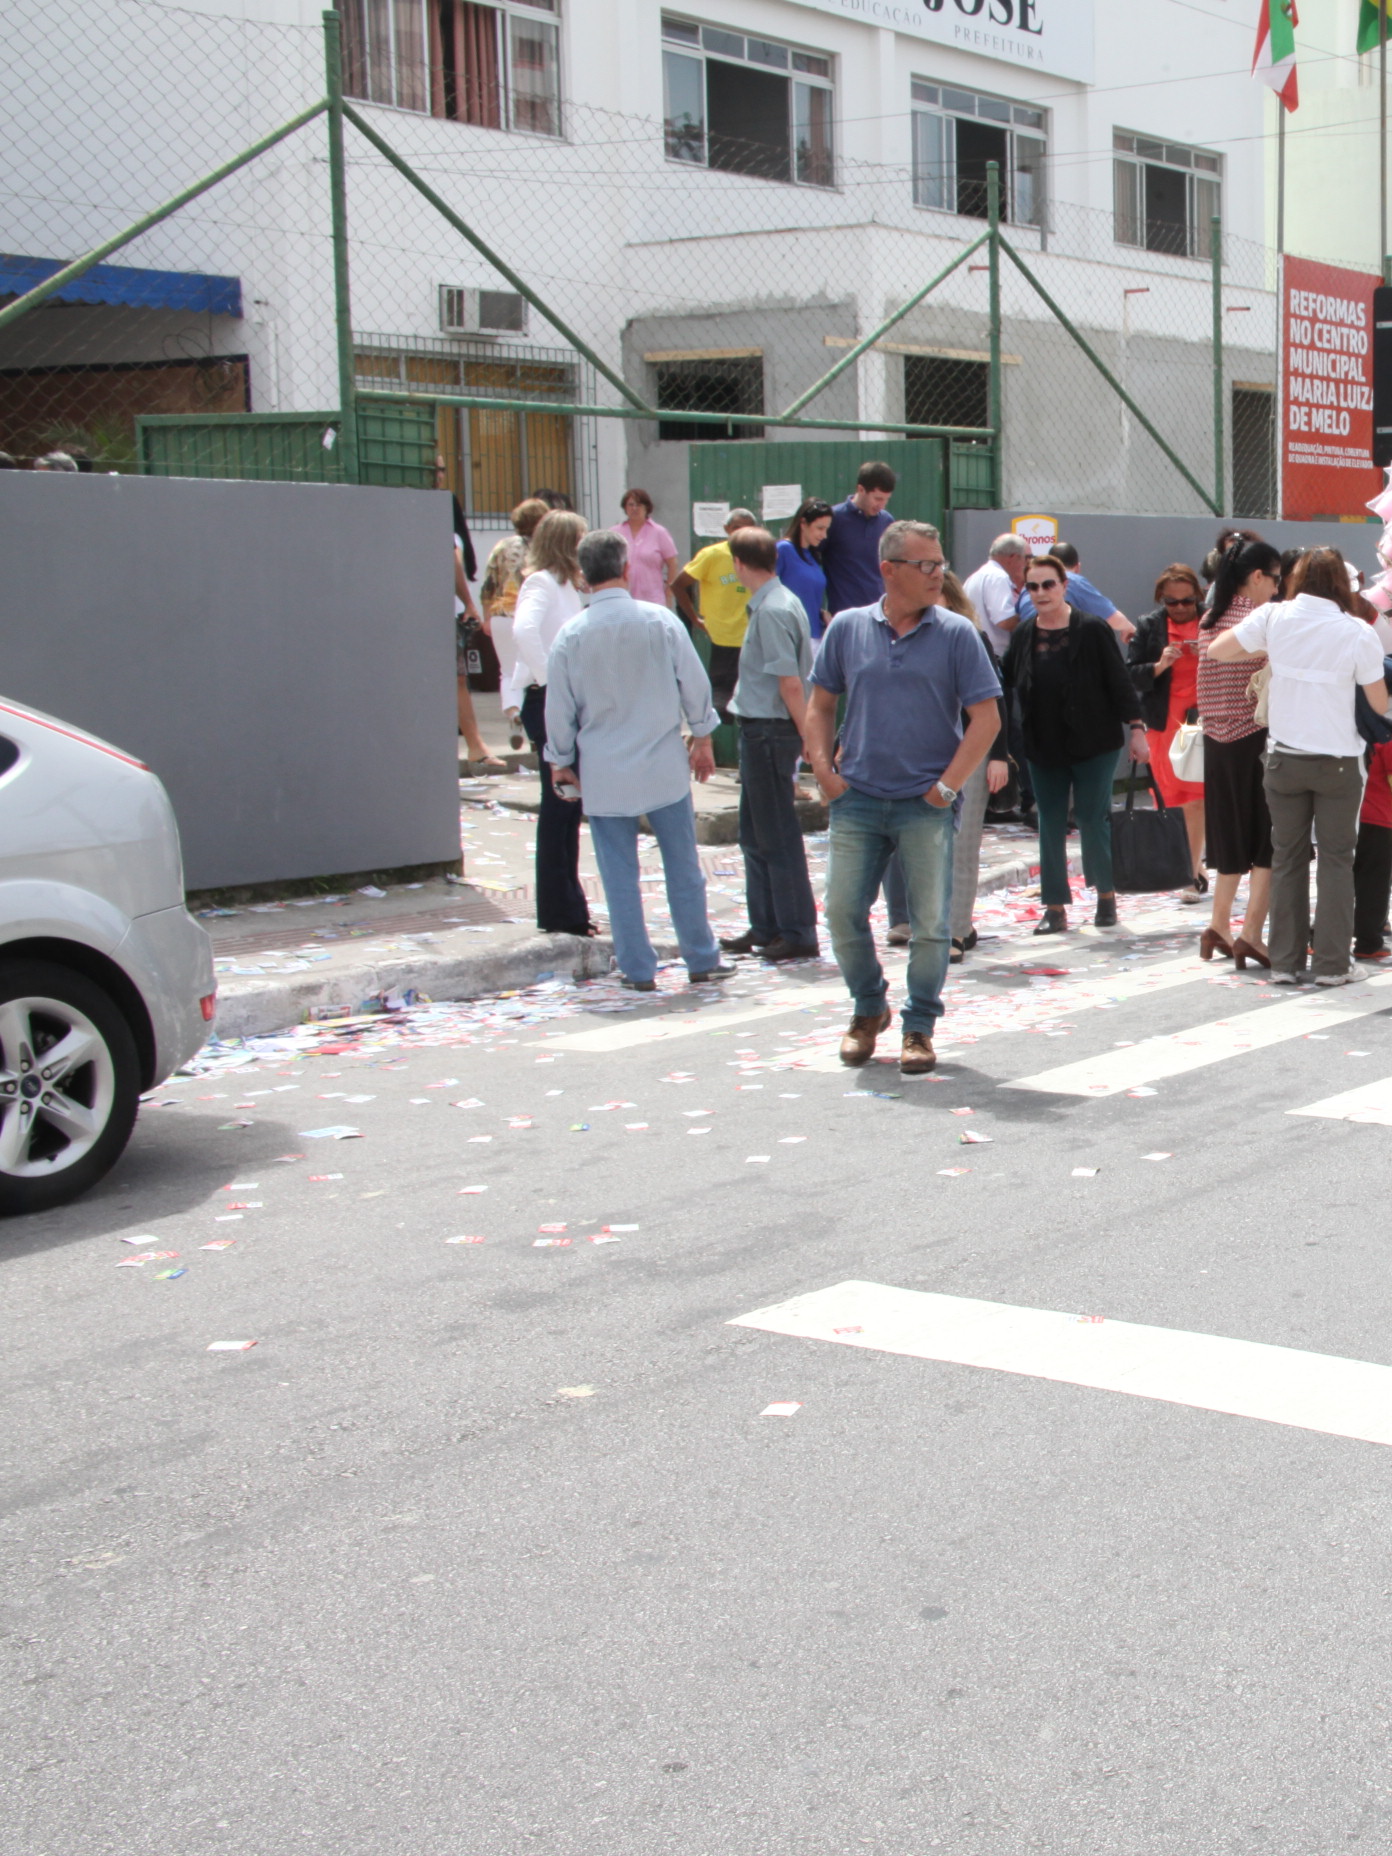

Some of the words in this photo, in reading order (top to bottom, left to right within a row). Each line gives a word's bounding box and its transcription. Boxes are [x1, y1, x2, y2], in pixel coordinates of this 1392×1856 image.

[954, 24, 1044, 62] PREFEITURA
[1289, 288, 1366, 327] REFORMAS
[1289, 318, 1312, 346] NO
[1314, 322, 1368, 355] CENTRO
[1289, 347, 1367, 383] MUNICIPAL
[1289, 376, 1338, 407] MARIA
[1289, 405, 1310, 432] DE
[1311, 408, 1351, 436] MELO
[1019, 533, 1056, 544] hronos
